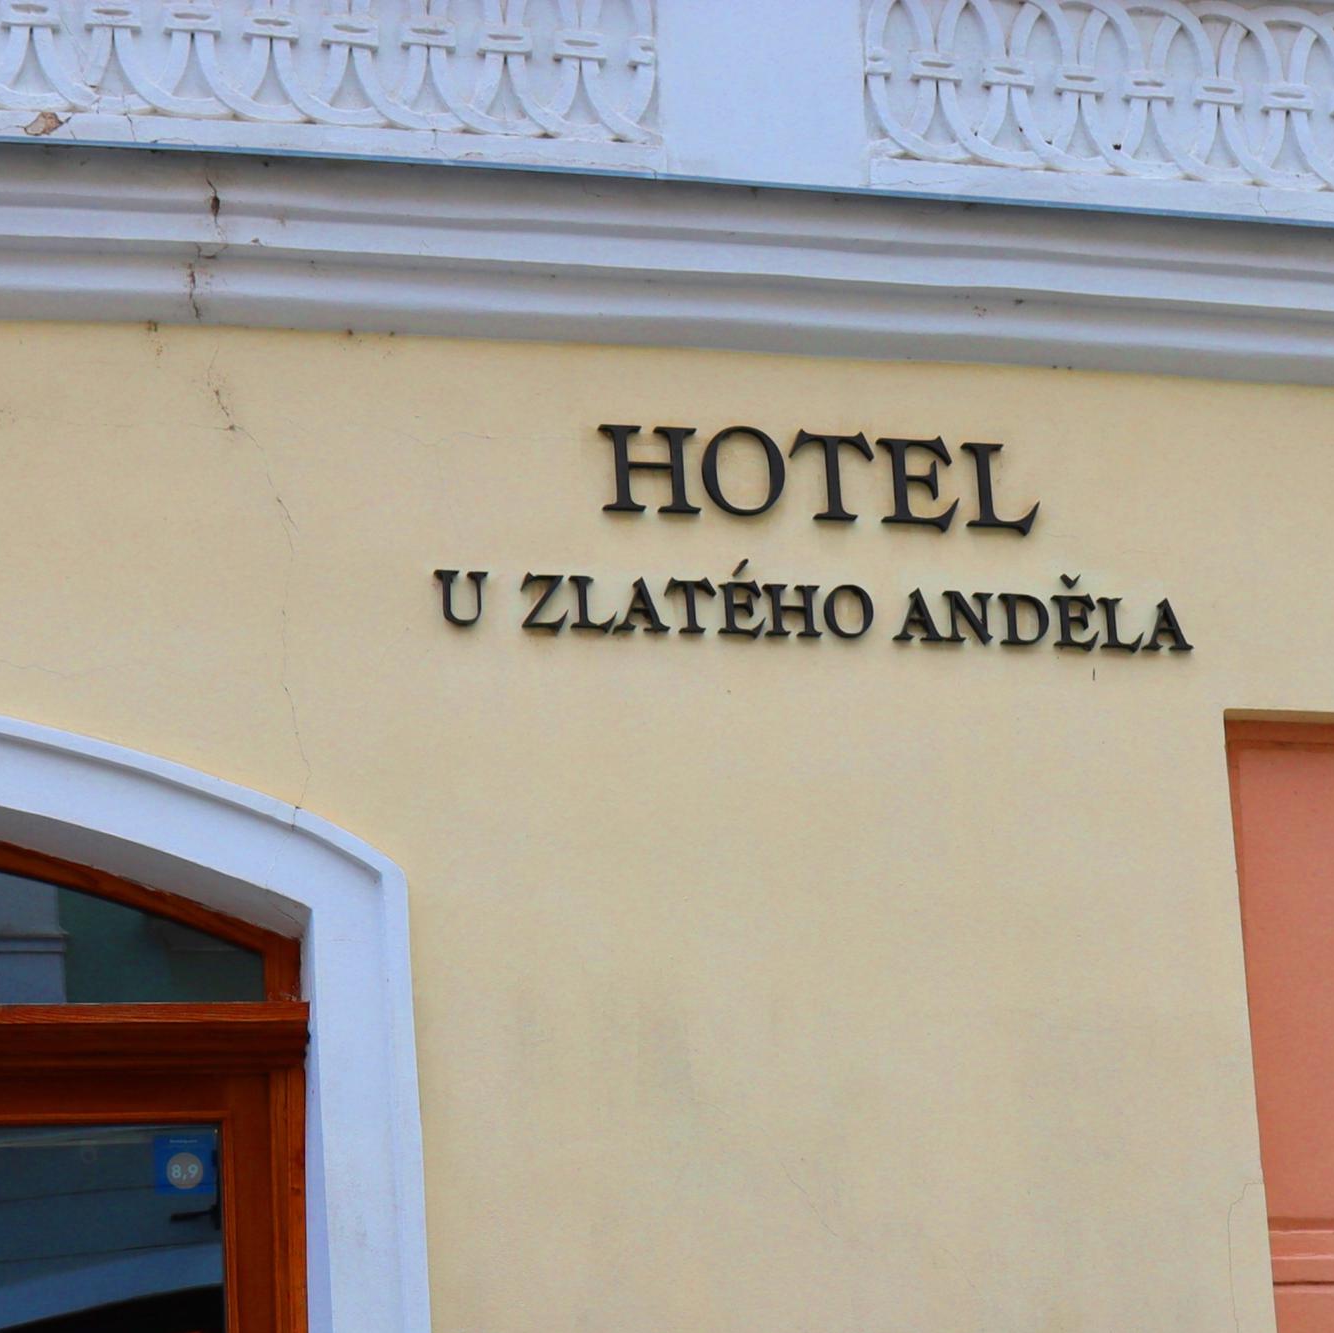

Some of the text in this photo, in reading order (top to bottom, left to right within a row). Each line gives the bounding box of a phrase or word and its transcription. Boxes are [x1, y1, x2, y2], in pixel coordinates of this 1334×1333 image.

[598, 424, 1040, 536] HOTEL
[434, 559, 1194, 652] U ZLATÉHO ANDĚLA
[171, 1164, 198, 1181] 8,9
